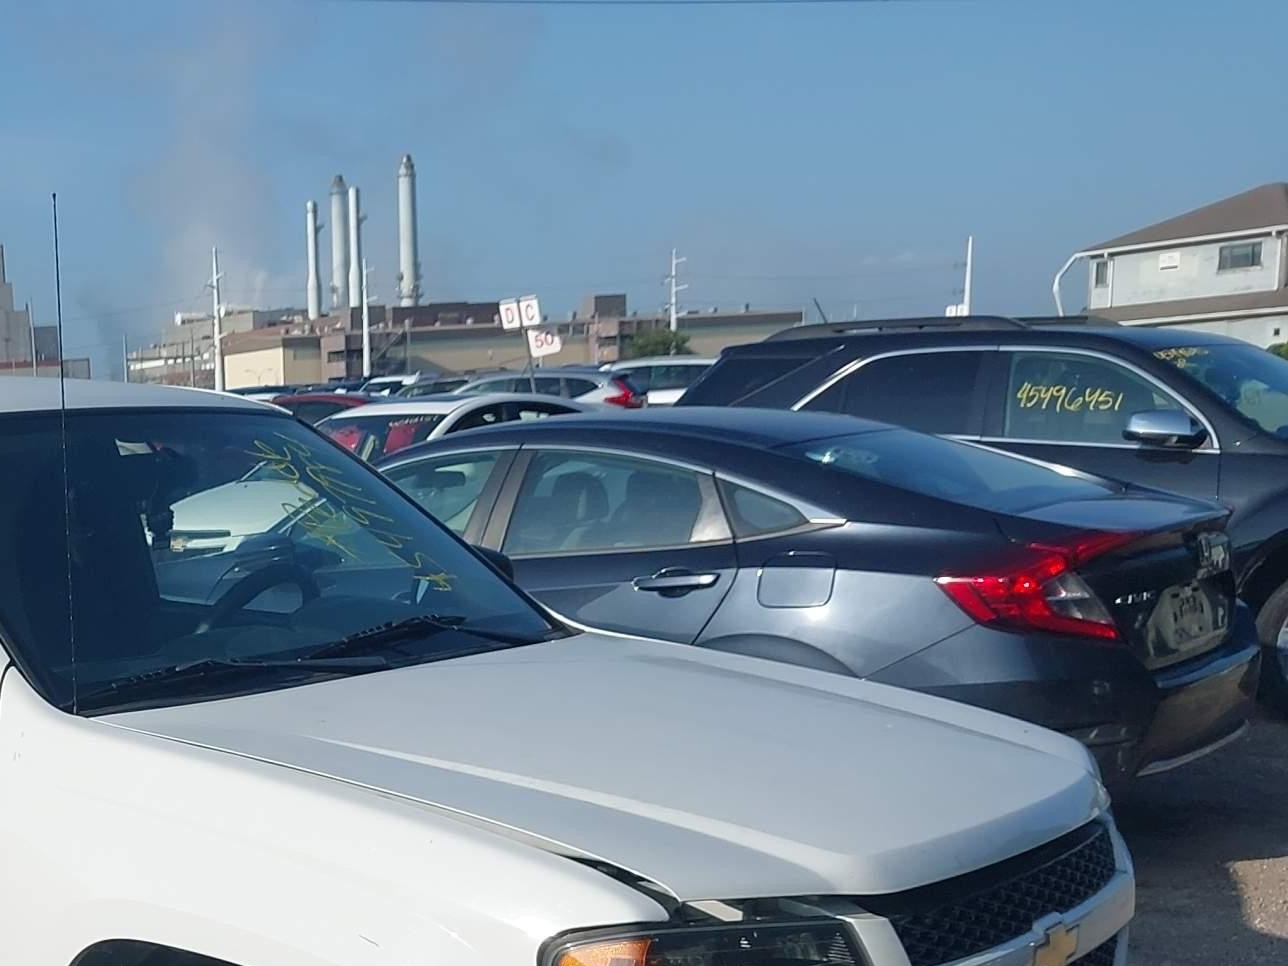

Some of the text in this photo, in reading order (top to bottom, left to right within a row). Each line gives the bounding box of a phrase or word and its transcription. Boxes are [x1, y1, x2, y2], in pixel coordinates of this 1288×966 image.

[504, 304, 536, 324] D C
[535, 331, 554, 348] 50
[1016, 381, 1124, 413] 45496451
